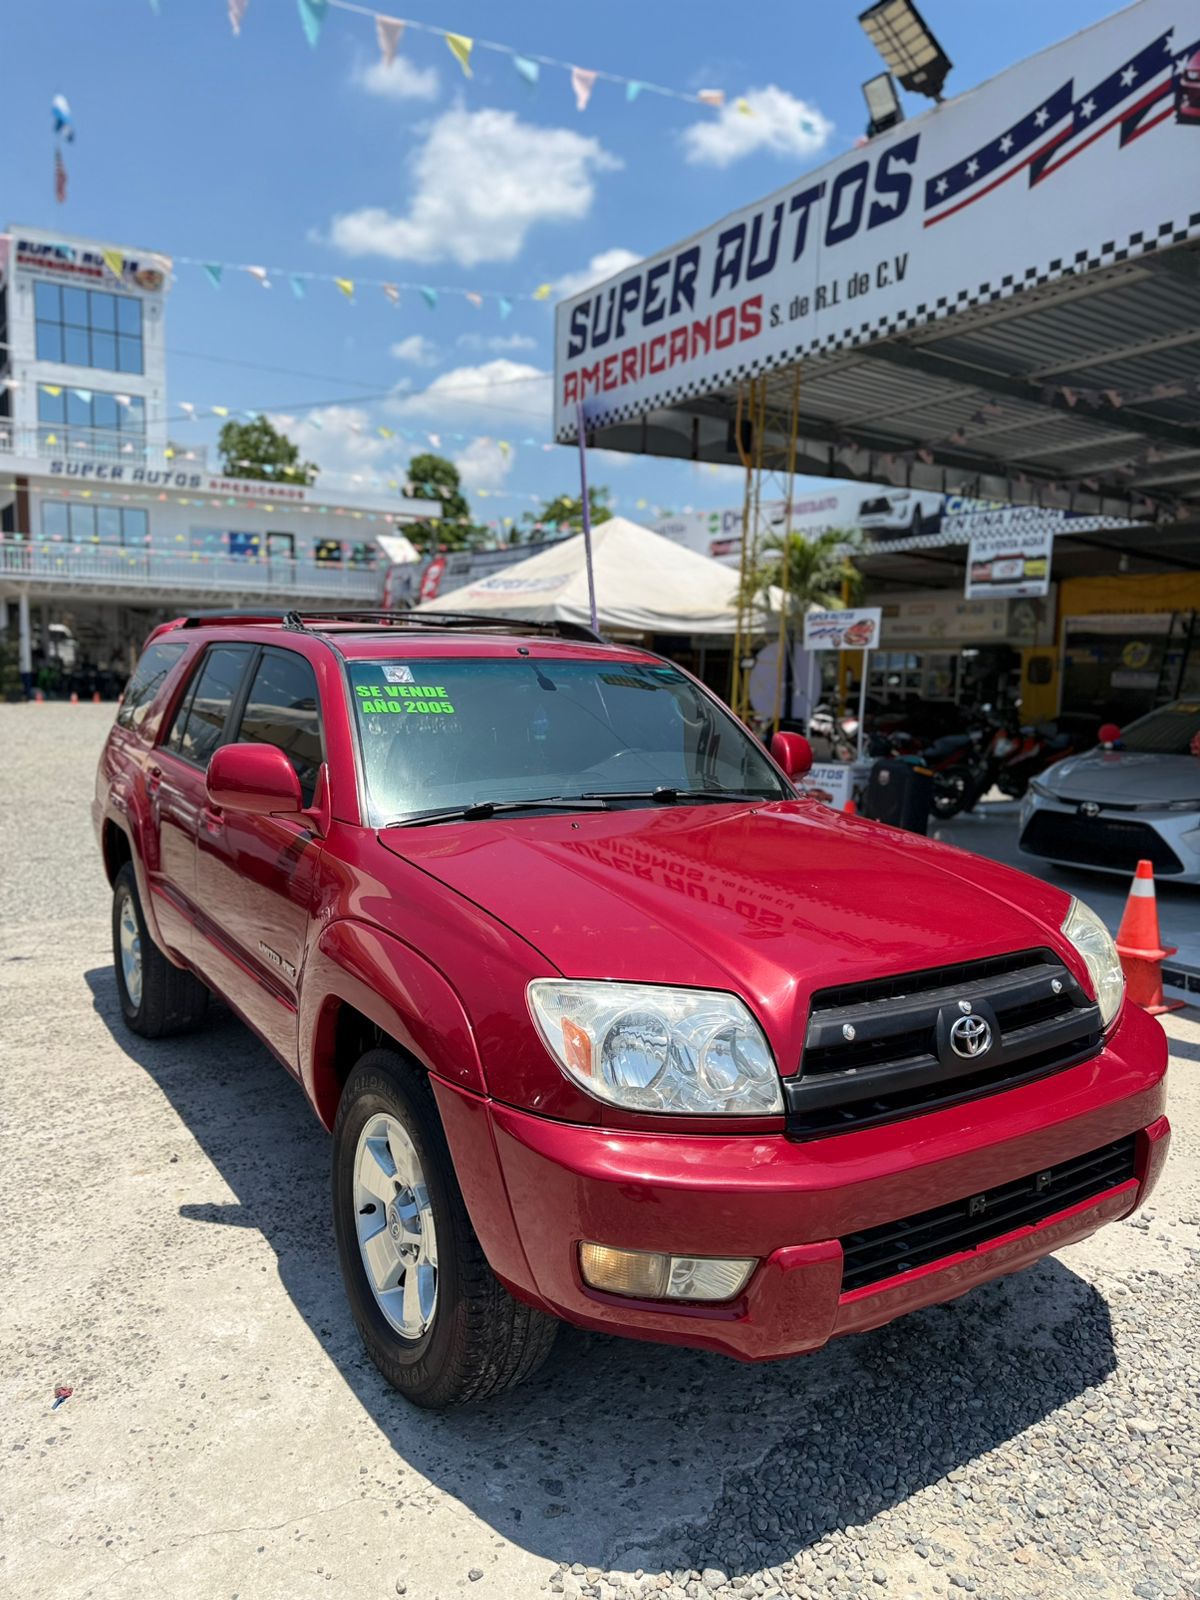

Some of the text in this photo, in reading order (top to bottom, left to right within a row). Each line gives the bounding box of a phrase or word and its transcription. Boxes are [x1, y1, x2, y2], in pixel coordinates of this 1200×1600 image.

[568, 132, 921, 359] SUPER AUTOS
[789, 295, 809, 321] de
[847, 272, 869, 300] de
[563, 293, 763, 406] AMERICANOS
[50, 461, 124, 479] SUPER
[132, 469, 201, 488] AUTOS
[355, 685, 449, 698] SE VENDE
[362, 698, 455, 714] AÑO 2005
